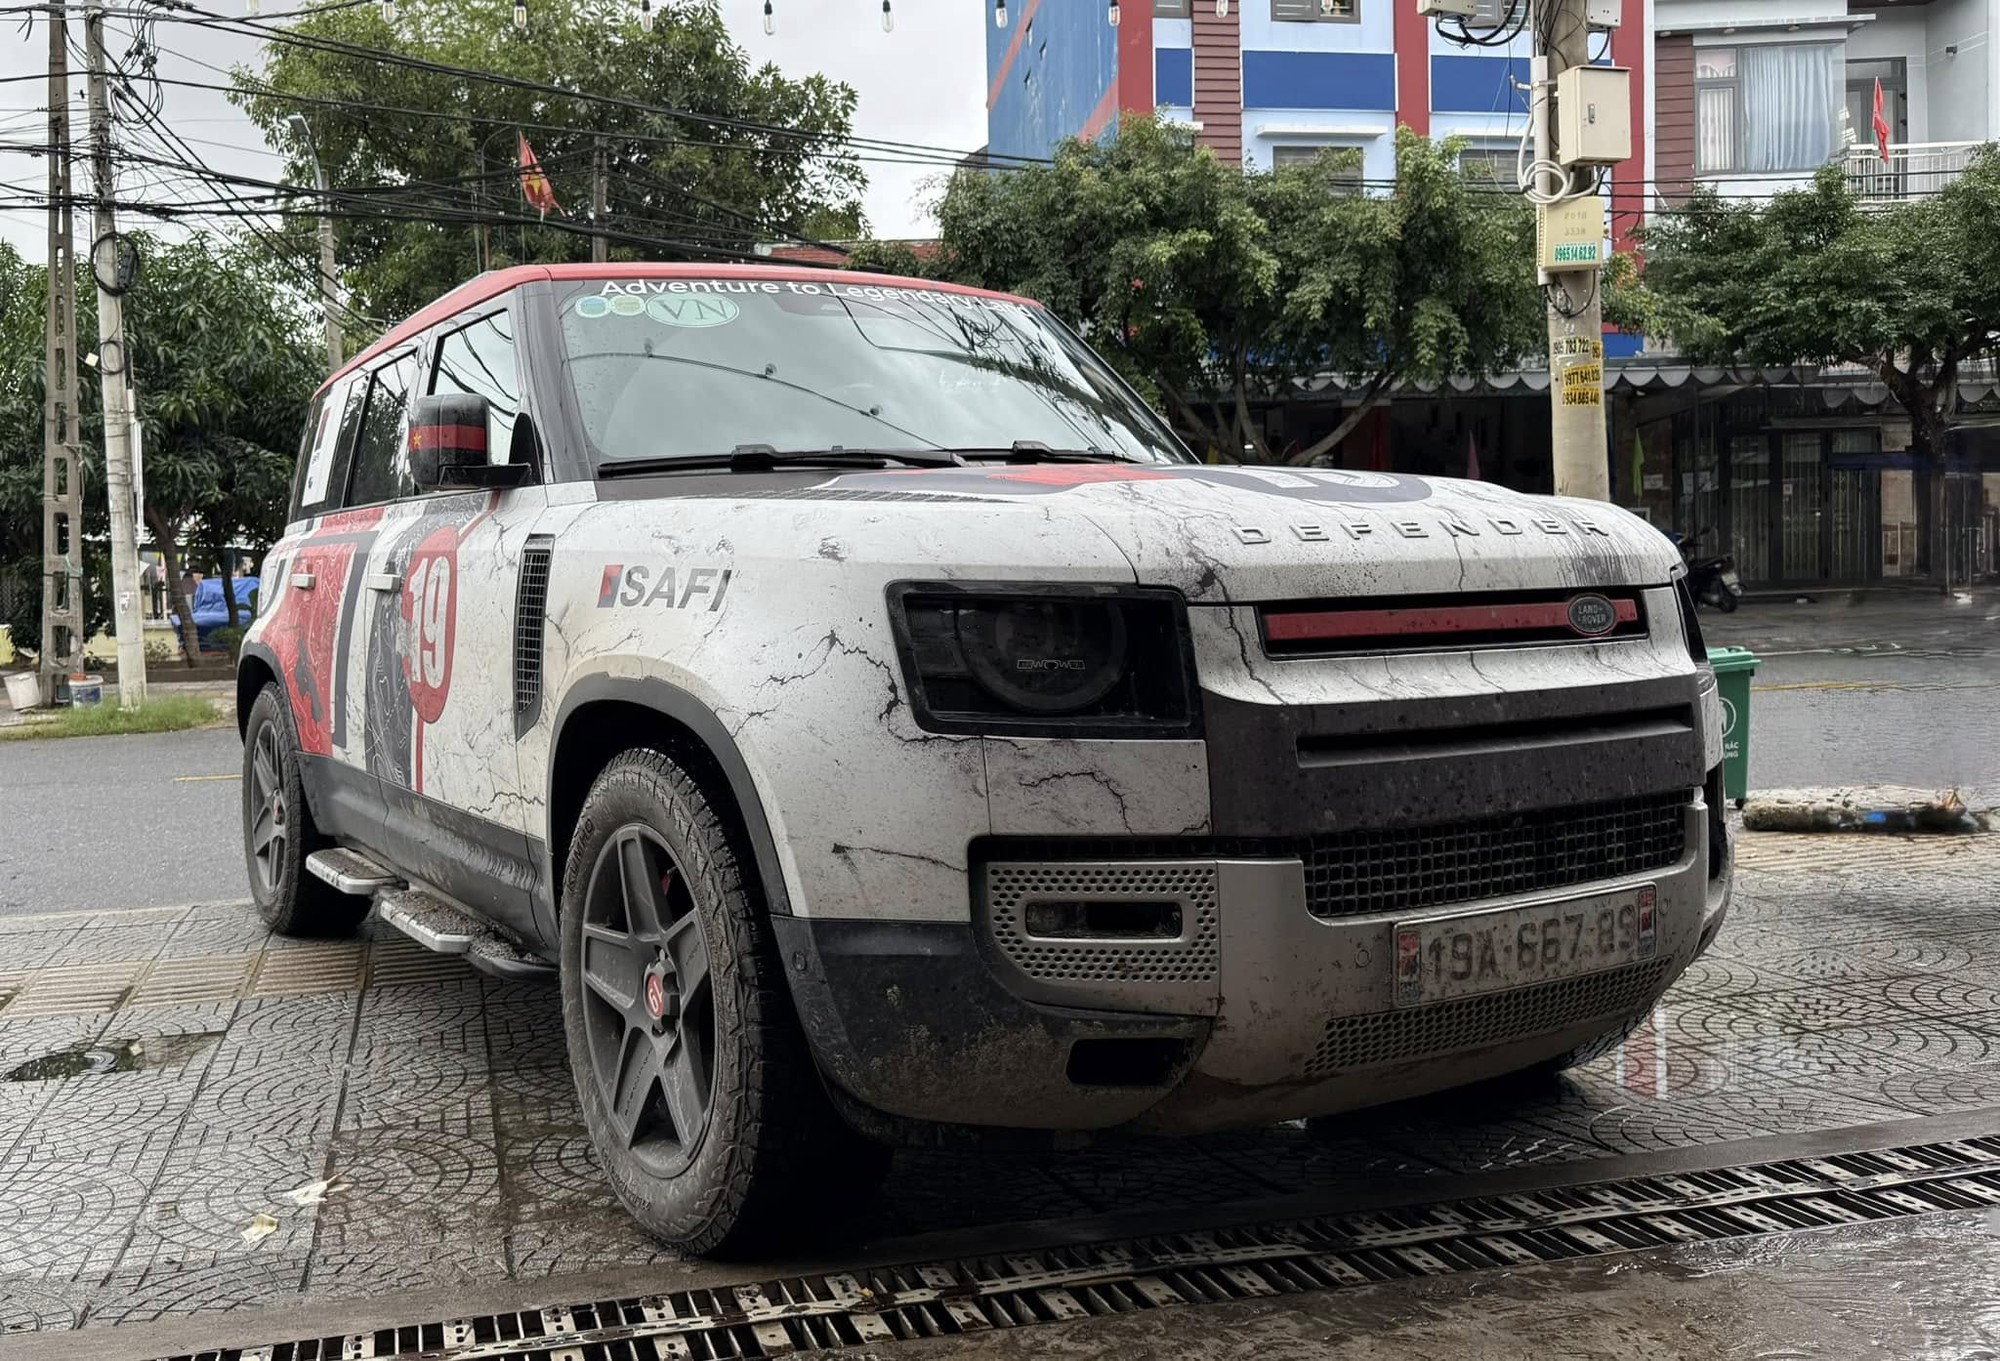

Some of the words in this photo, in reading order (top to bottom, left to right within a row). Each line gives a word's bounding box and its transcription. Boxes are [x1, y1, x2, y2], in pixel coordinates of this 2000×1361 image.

[600, 279, 780, 297] Adventure
[785, 280, 821, 296] to
[827, 282, 973, 309] Legendary
[975, 296, 1037, 319] Land
[657, 299, 729, 321] VN
[1230, 517, 1609, 545] DEFENDER
[619, 565, 732, 612] SAFI
[408, 555, 450, 690] 19
